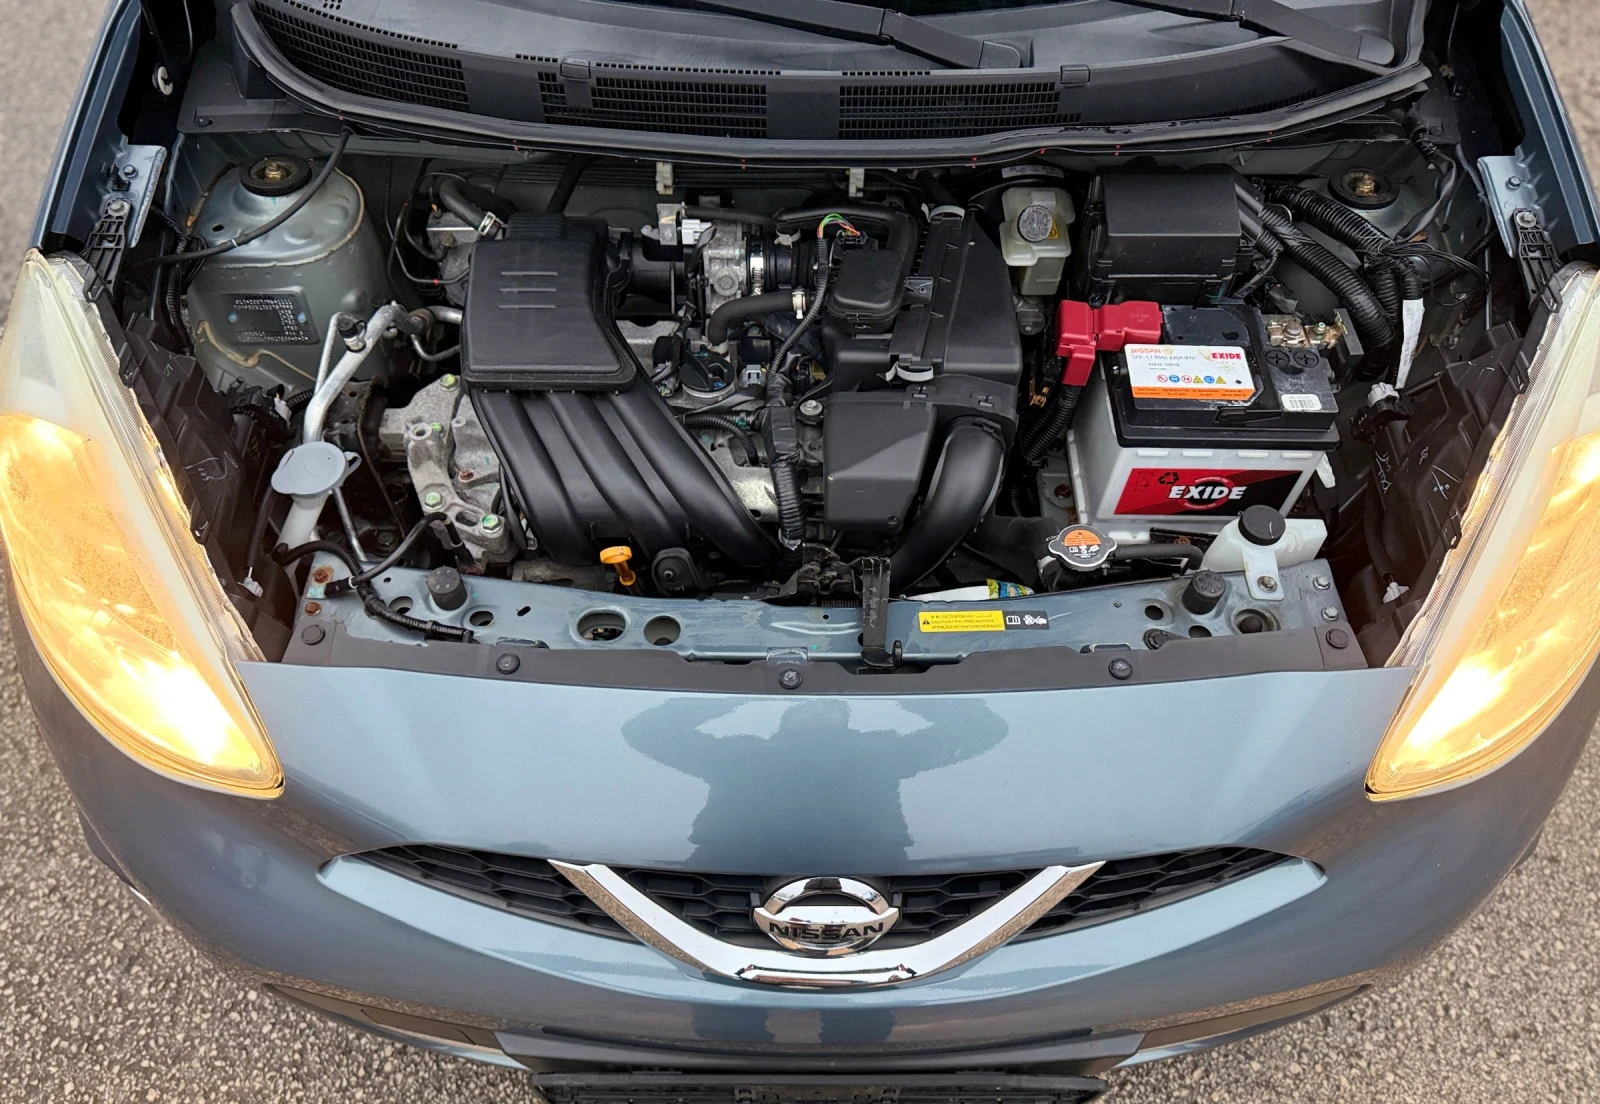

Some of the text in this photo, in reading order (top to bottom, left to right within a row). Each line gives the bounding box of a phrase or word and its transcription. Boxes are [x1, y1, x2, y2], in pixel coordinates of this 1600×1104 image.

[1211, 352, 1242, 360] EXIDE
[1168, 485, 1247, 499] EXIDE
[769, 922, 883, 940] NISSAN
